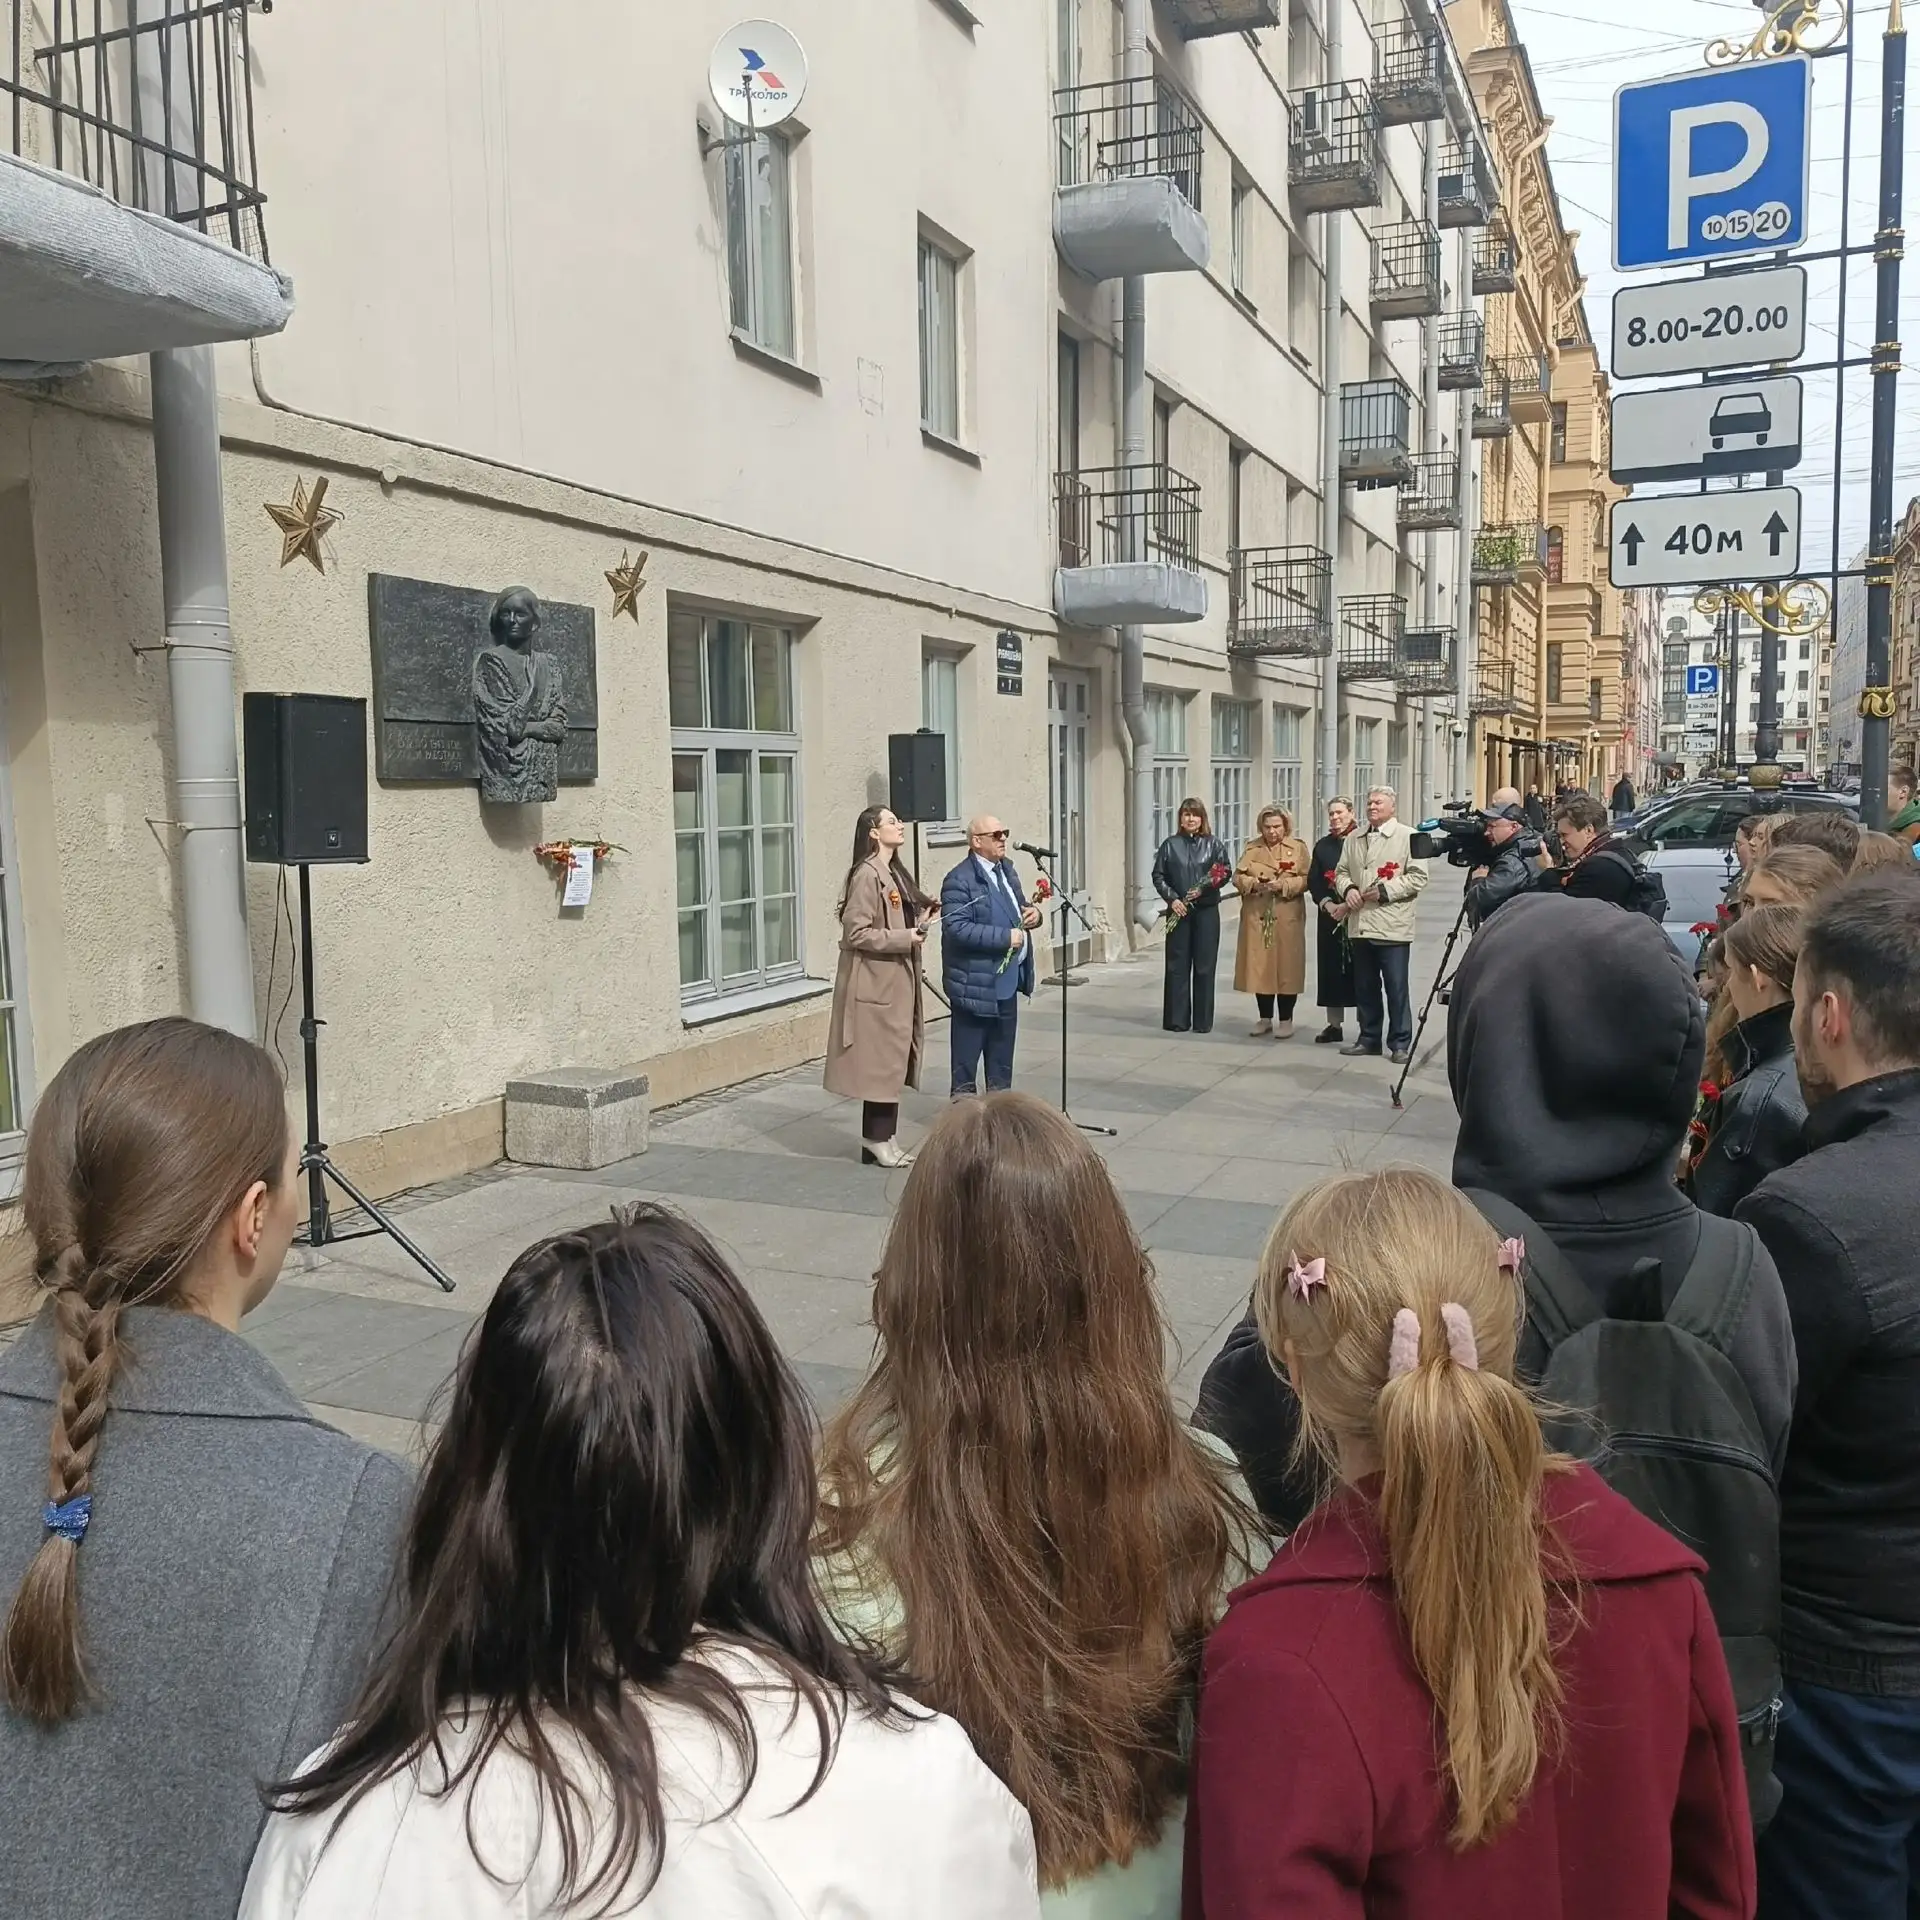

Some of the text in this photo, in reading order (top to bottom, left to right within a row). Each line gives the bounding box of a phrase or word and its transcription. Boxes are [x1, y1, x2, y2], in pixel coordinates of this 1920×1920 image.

[729, 87, 788, 100] ТРИКОЛОР
[1668, 101, 1769, 250] P
[1707, 208, 1787, 234] 10 15 20
[1627, 305, 1788, 347] 8.00-20.00
[1694, 667, 1713, 692] P
